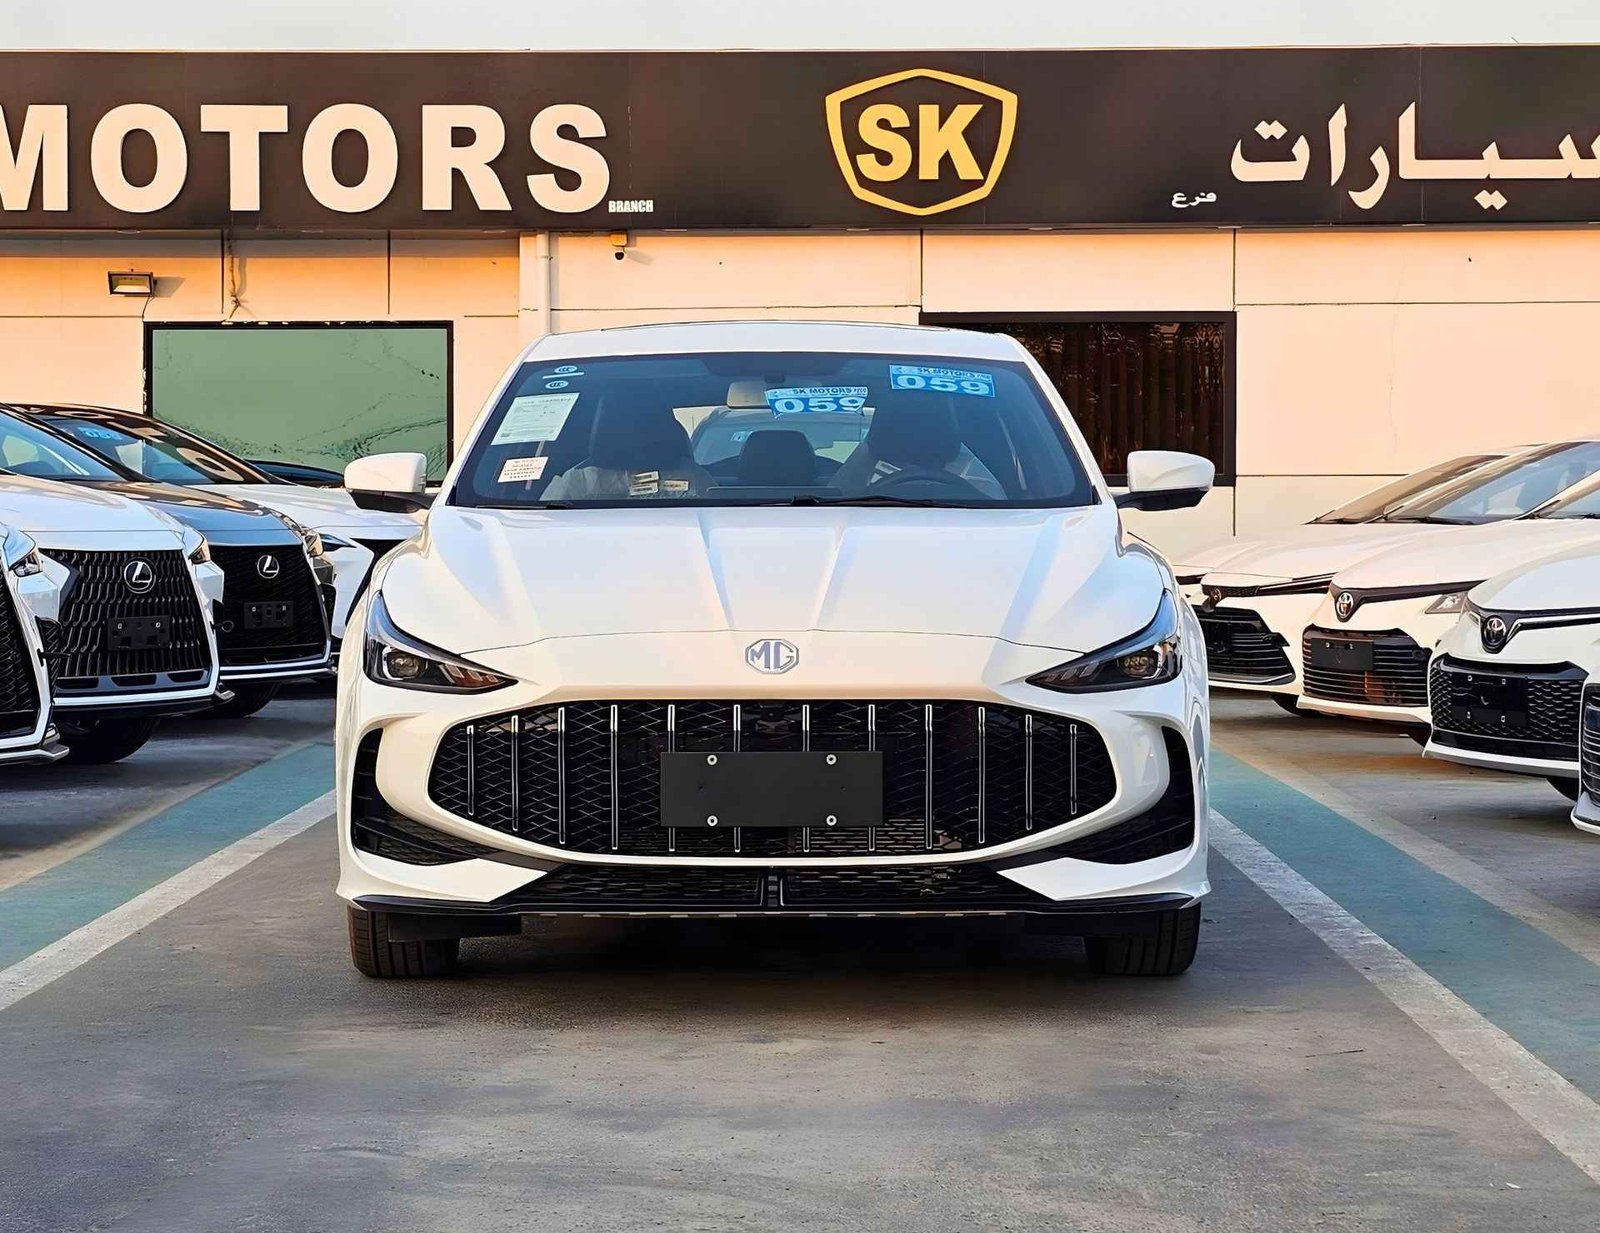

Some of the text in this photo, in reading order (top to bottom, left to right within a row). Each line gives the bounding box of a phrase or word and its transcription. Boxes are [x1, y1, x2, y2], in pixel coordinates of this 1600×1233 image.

[856, 103, 985, 182] SK
[0, 103, 611, 213] MOTORS
[608, 199, 654, 213] BRANCH
[1171, 191, 1217, 208] فرع
[793, 387, 807, 395] SK
[809, 386, 852, 395] MOTORS
[896, 375, 990, 396] 059
[774, 397, 866, 413] 059
[749, 641, 795, 671] MG
